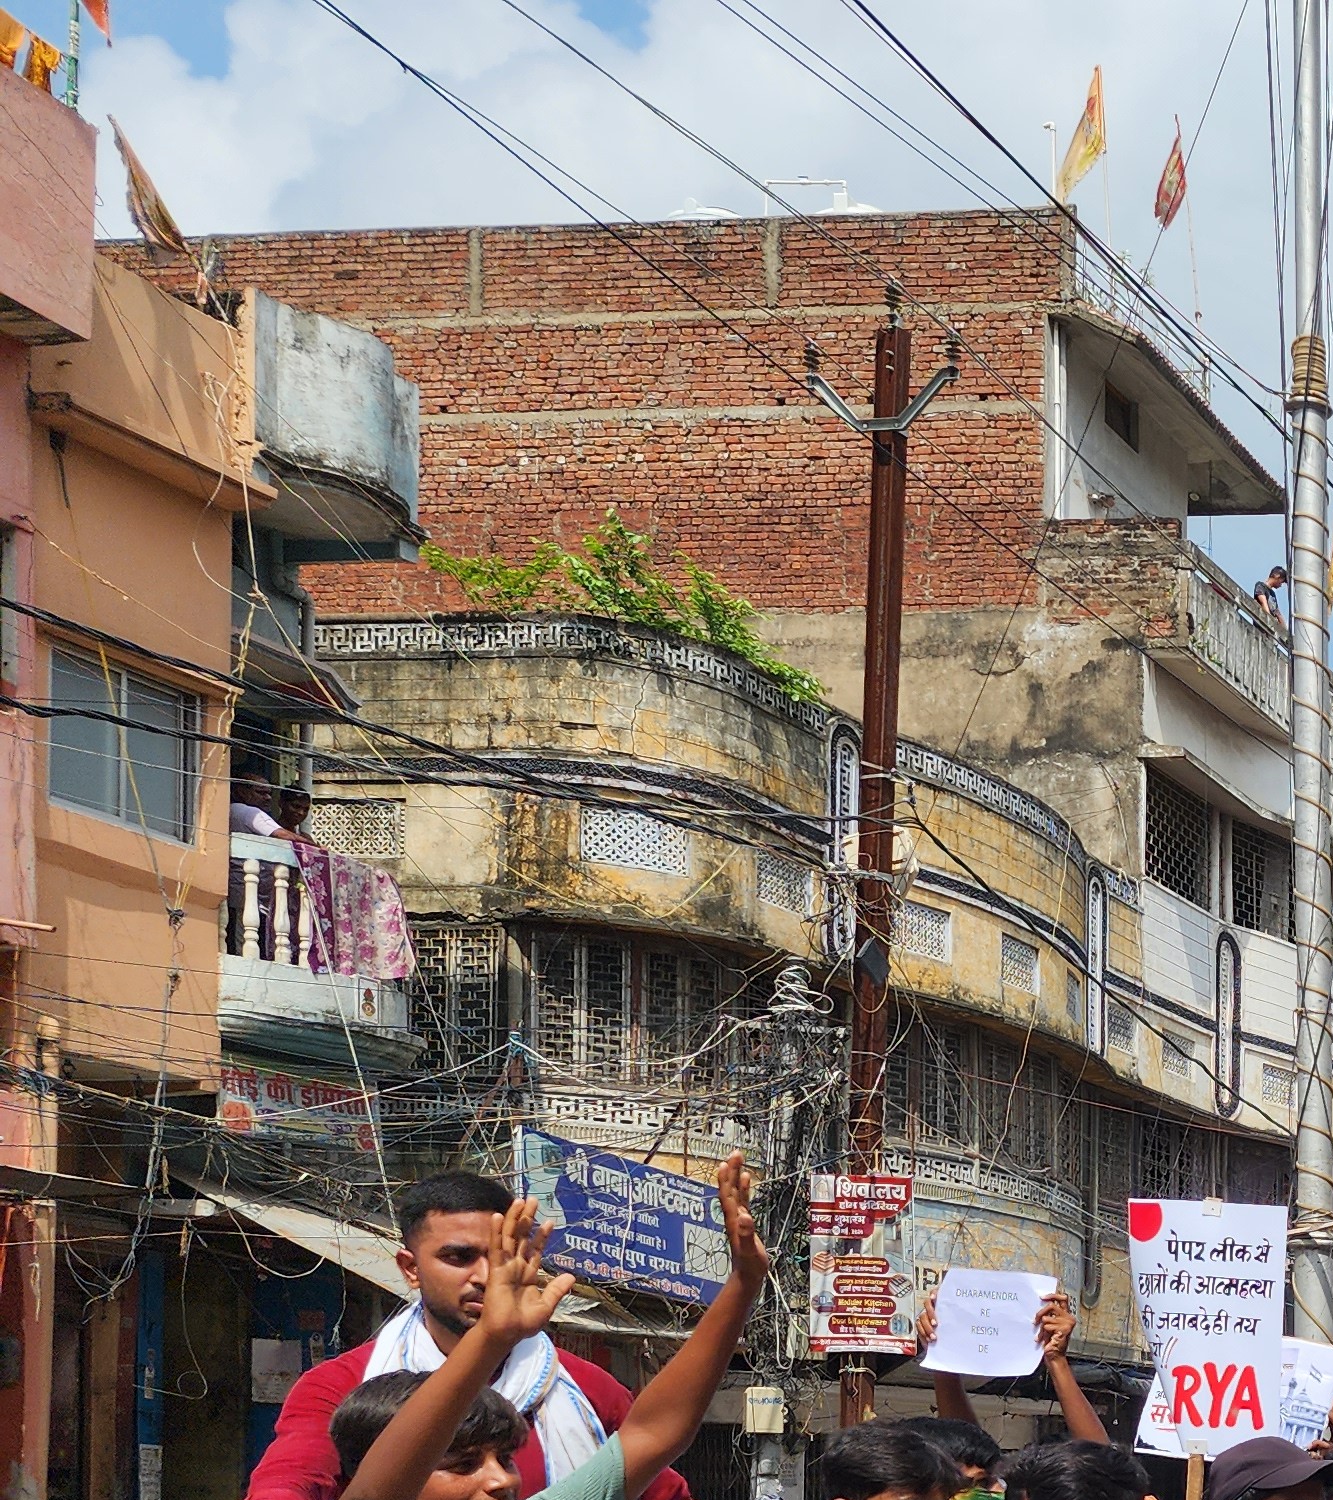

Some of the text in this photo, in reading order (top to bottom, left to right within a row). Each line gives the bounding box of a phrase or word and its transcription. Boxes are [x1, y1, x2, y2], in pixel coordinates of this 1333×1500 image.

[592, 1166, 629, 1198] बाबा
[836, 1175, 906, 1200] शिवालय
[1165, 1230, 1273, 1263] पेपर लीक से
[956, 1288, 1019, 1301] DHARAMENDRA
[1170, 1270, 1192, 1294] की
[1194, 1275, 1276, 1299] आत्महत्या
[971, 1325, 999, 1336] RESIGN
[1157, 1307, 1231, 1336] जवाबदेही
[1171, 1362, 1264, 1430] RYA
